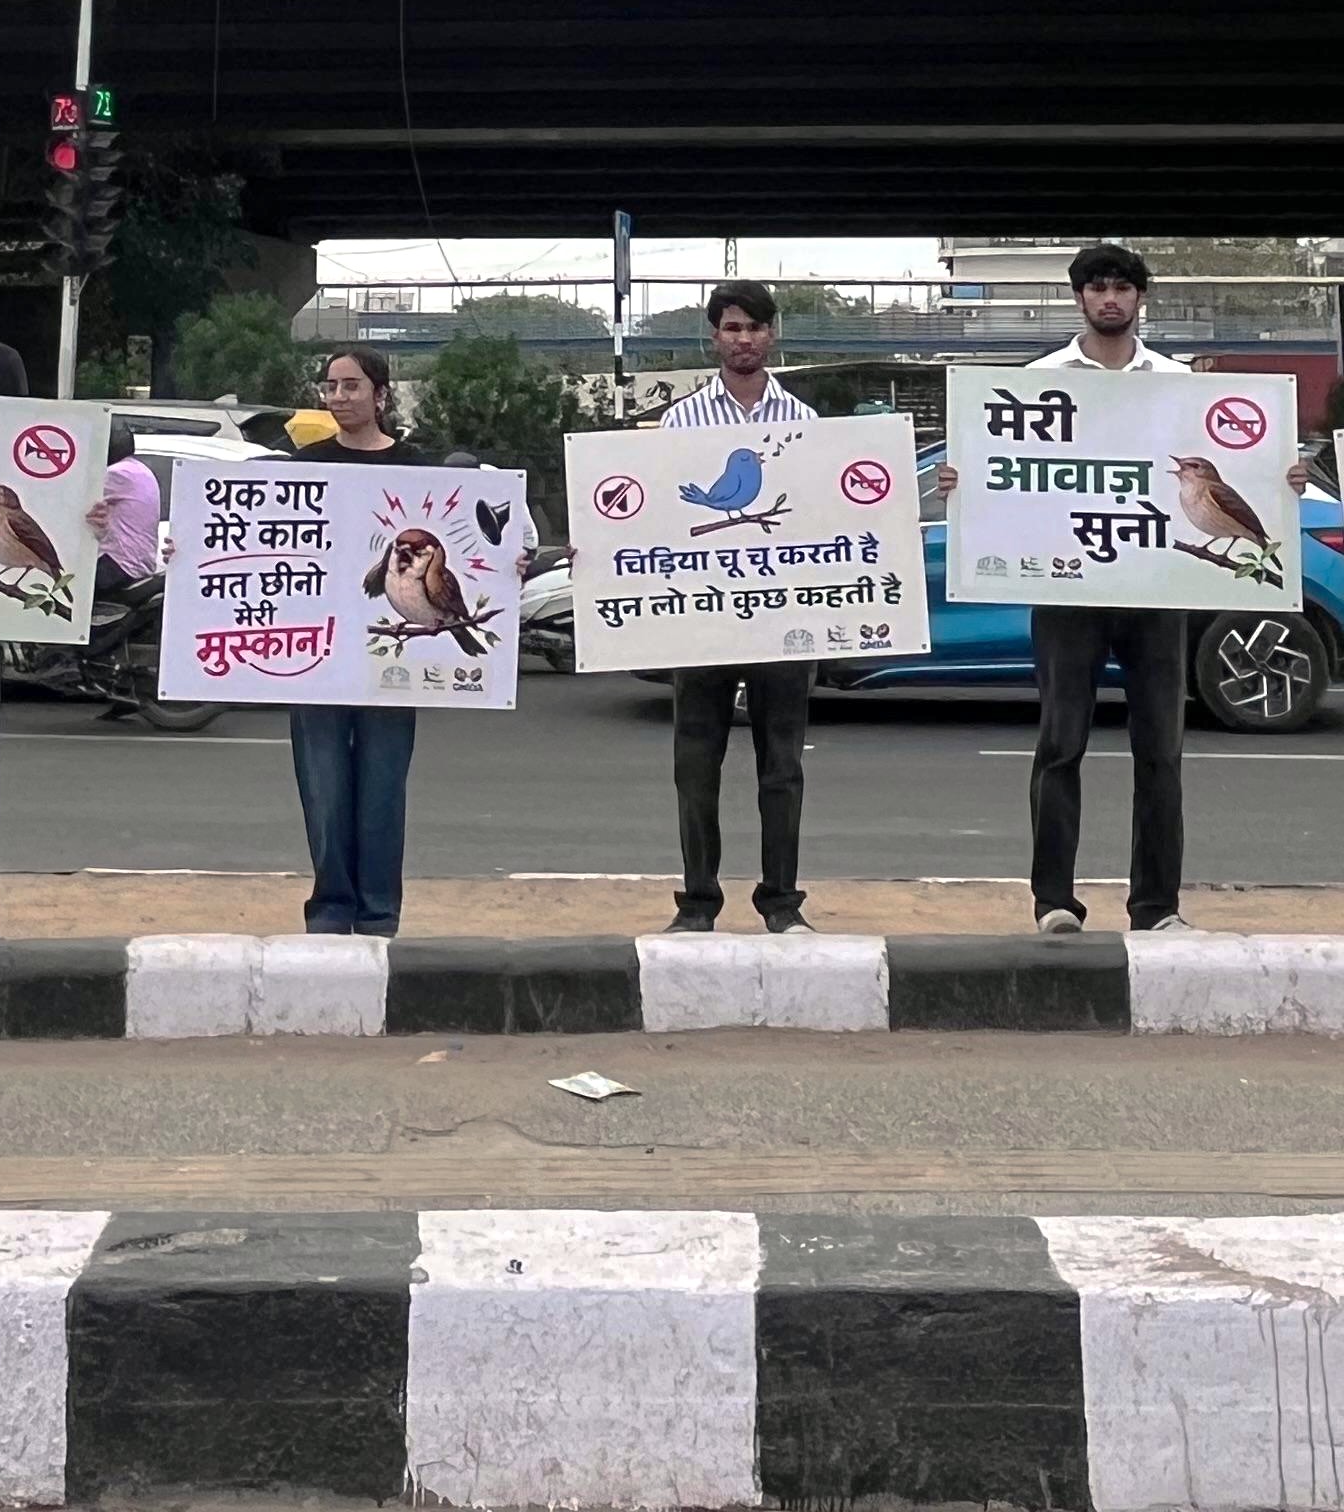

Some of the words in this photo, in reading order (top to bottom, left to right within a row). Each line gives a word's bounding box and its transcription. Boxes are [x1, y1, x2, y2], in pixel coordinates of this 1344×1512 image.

[984, 388, 1078, 442] मेरी
[205, 478, 268, 511] थक
[276, 480, 329, 514] गए
[986, 456, 1154, 504] आवाज़
[204, 512, 251, 551] मेरे
[258, 519, 333, 552] कान,
[613, 546, 709, 580] चिड़िया
[716, 548, 746, 578] चू
[747, 546, 777, 576] चू
[777, 535, 854, 565] करती
[858, 532, 880, 565] है
[1070, 500, 1171, 564] सुनो
[199, 572, 253, 599] मत
[259, 561, 327, 597] छीनो
[595, 596, 644, 628] सुन
[650, 587, 688, 616] लो
[693, 585, 725, 613] वो
[732, 588, 788, 620] कुछ
[794, 577, 875, 608] कहती
[879, 572, 902, 605] है
[233, 599, 278, 626] मेरी
[196, 616, 336, 677] मुस्कान!
